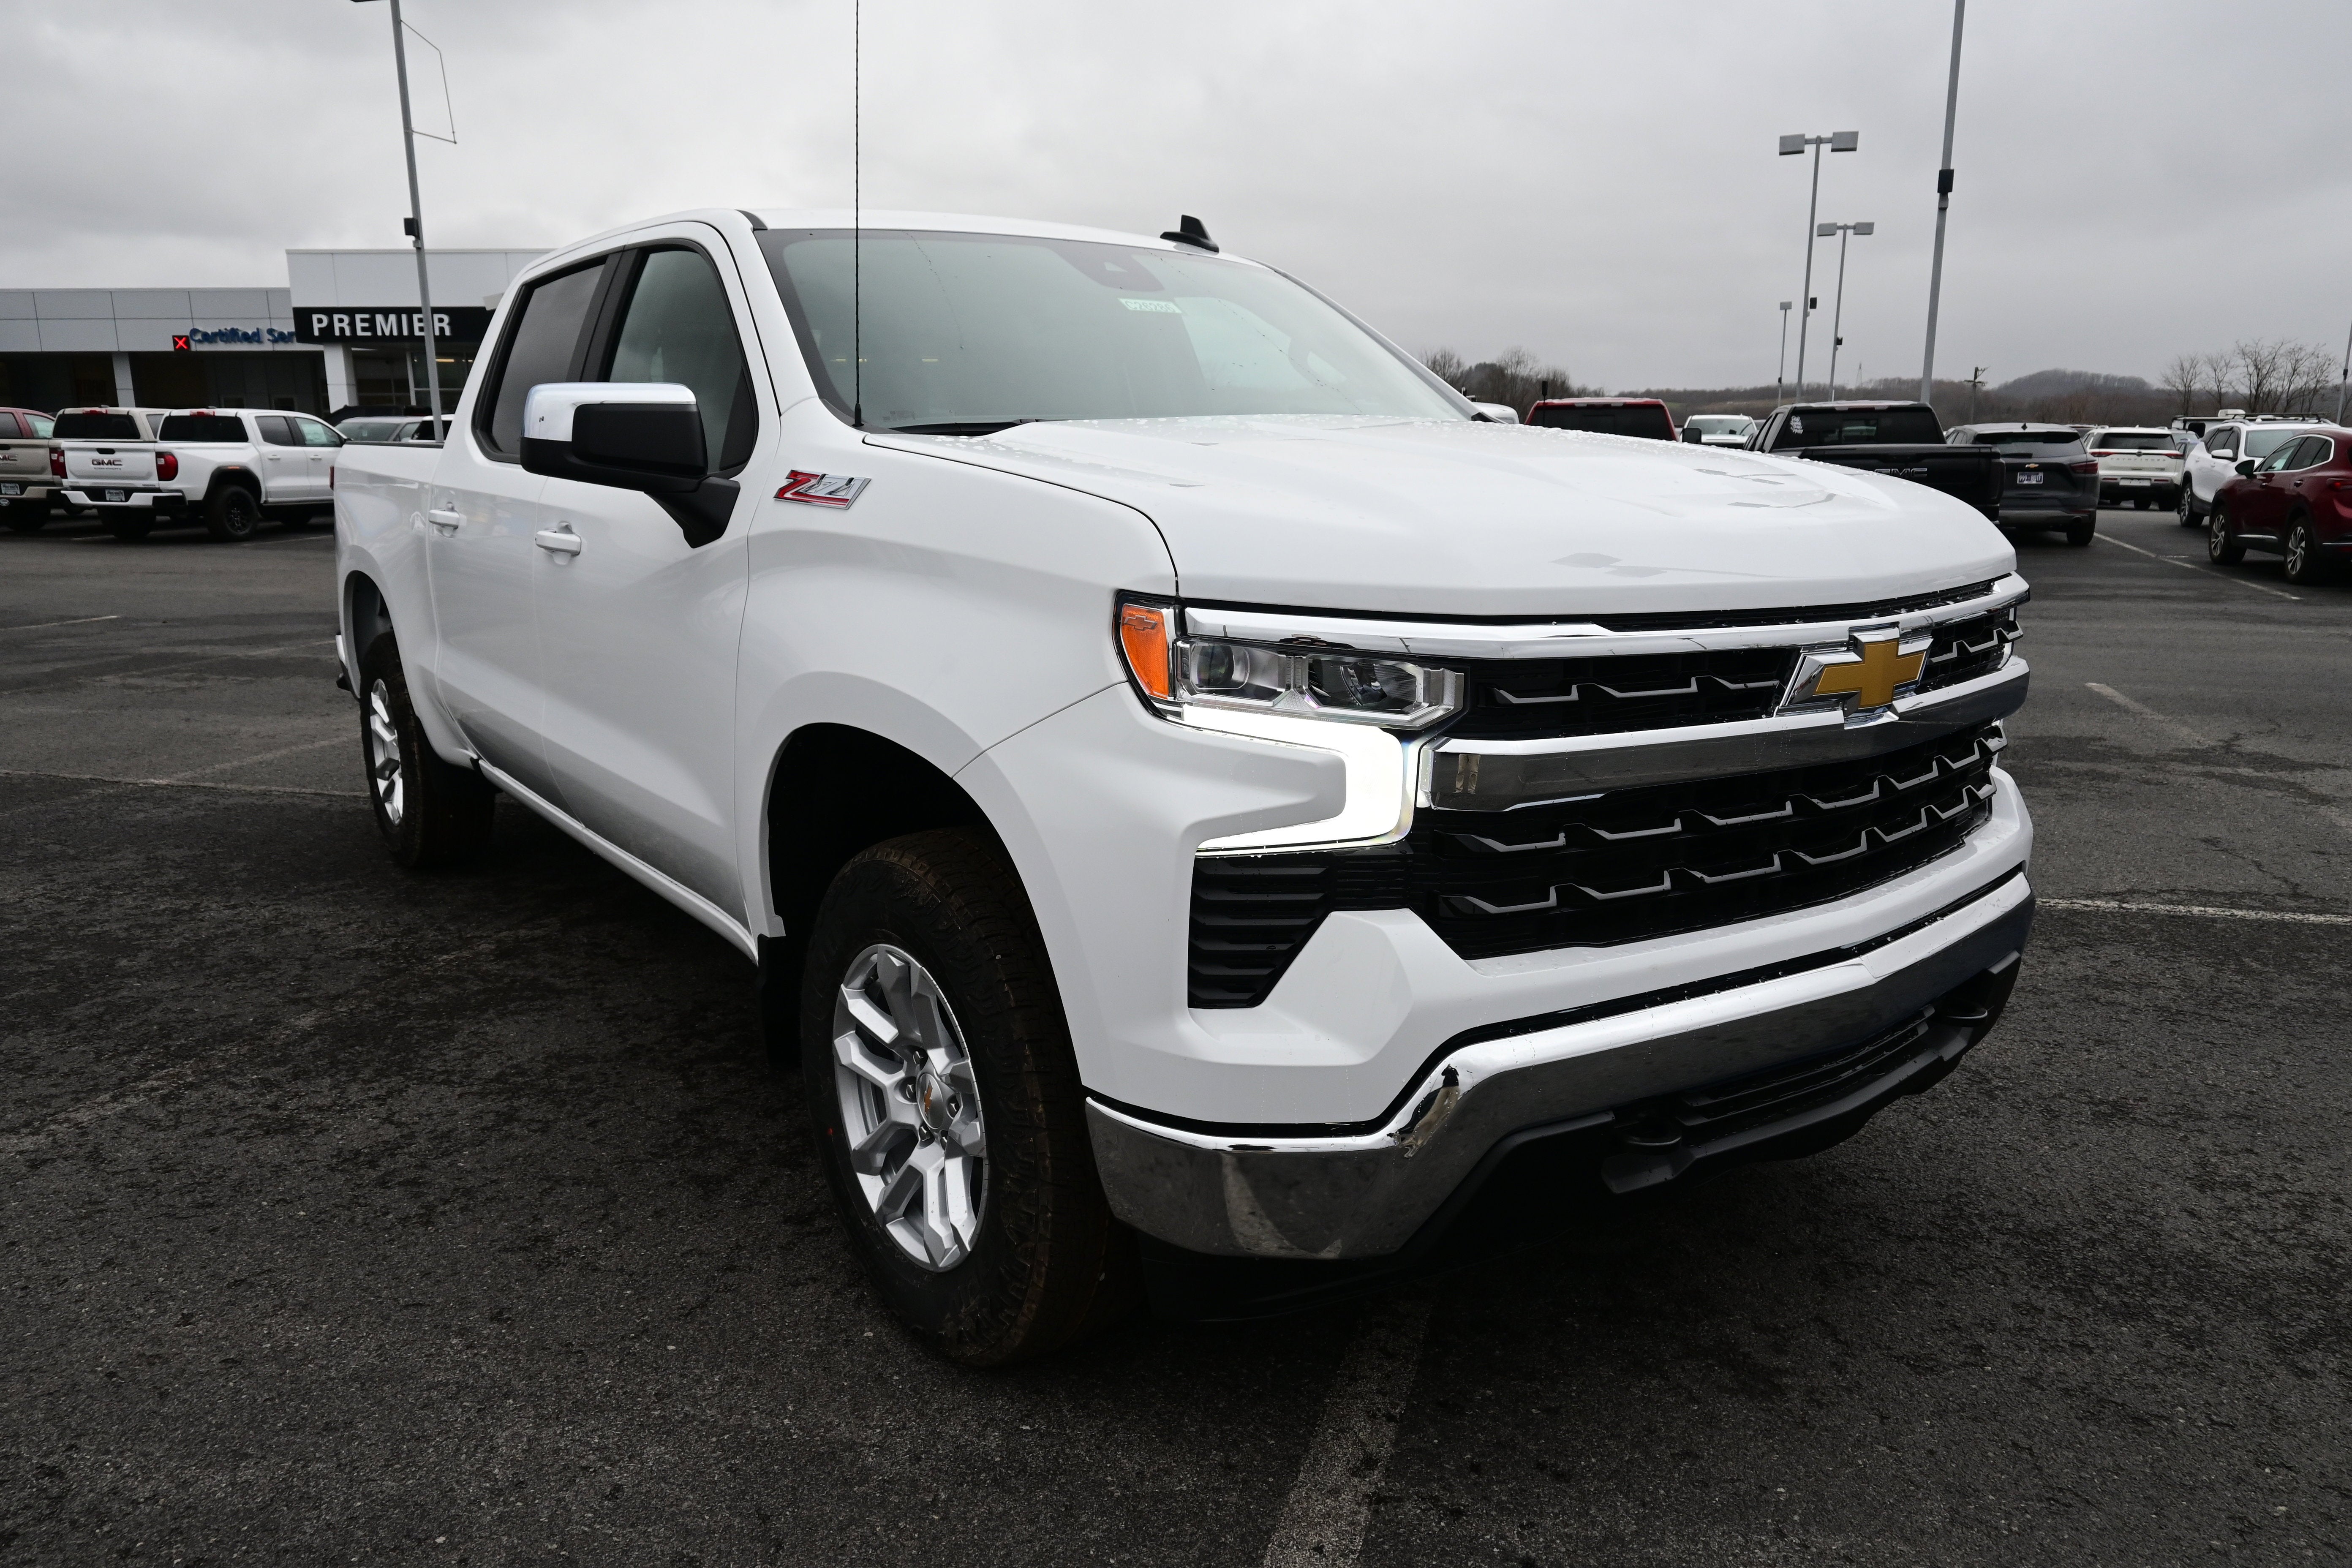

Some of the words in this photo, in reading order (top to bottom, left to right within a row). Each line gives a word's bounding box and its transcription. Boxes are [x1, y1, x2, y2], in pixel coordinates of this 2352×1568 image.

[189, 327, 263, 343] Certified
[267, 327, 296, 343] Ser
[312, 313, 452, 336] PREMIER
[773, 469, 872, 510] Z71
